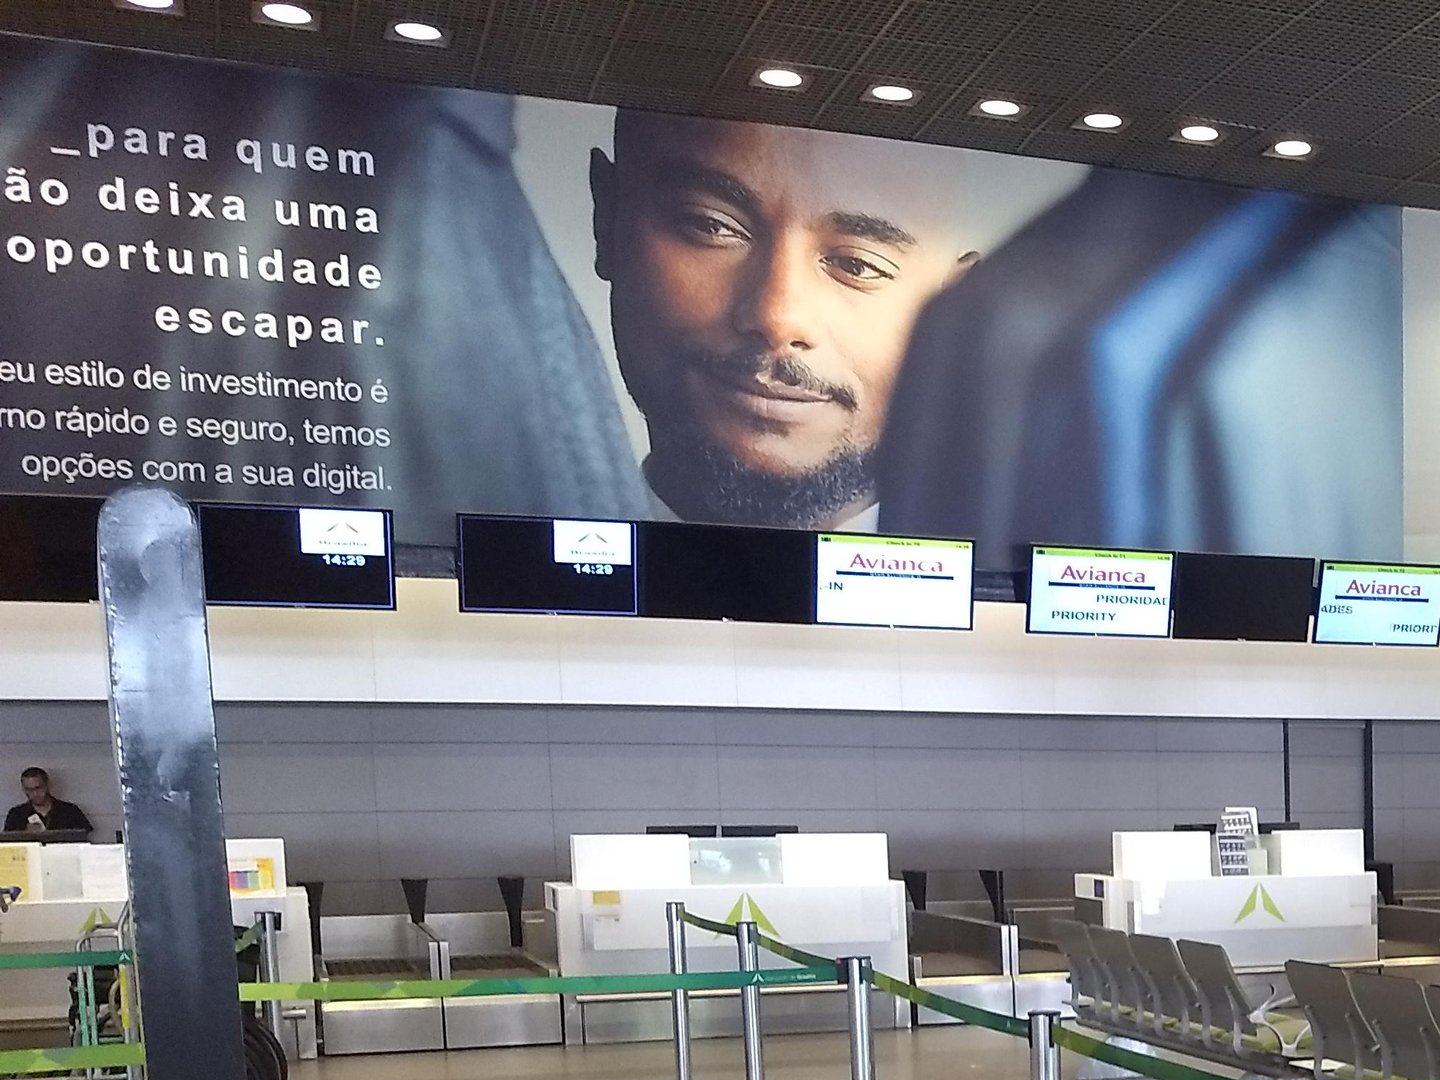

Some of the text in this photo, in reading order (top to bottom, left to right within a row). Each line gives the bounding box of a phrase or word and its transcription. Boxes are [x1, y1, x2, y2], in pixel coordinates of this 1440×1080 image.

[236, 138, 375, 176] quem
[98, 176, 247, 222] deixa
[274, 199, 380, 234] uma
[6, 235, 383, 290] oportunidade
[154, 304, 385, 348] escapar.
[44, 360, 125, 388] estilo
[133, 364, 171, 390] de
[180, 366, 363, 402] investimento
[370, 378, 389, 404] é
[55, 405, 150, 438] rápido
[158, 415, 177, 436] e
[186, 416, 295, 446] seguro,
[303, 419, 391, 447] temos
[21, 452, 392, 494] opções com a sua digital.
[322, 553, 366, 567] 14:29
[850, 553, 943, 573] Avianca
[1060, 564, 1146, 584] Avianca
[1346, 579, 1422, 597] Avianca
[1051, 610, 1116, 622] PRIORITY
